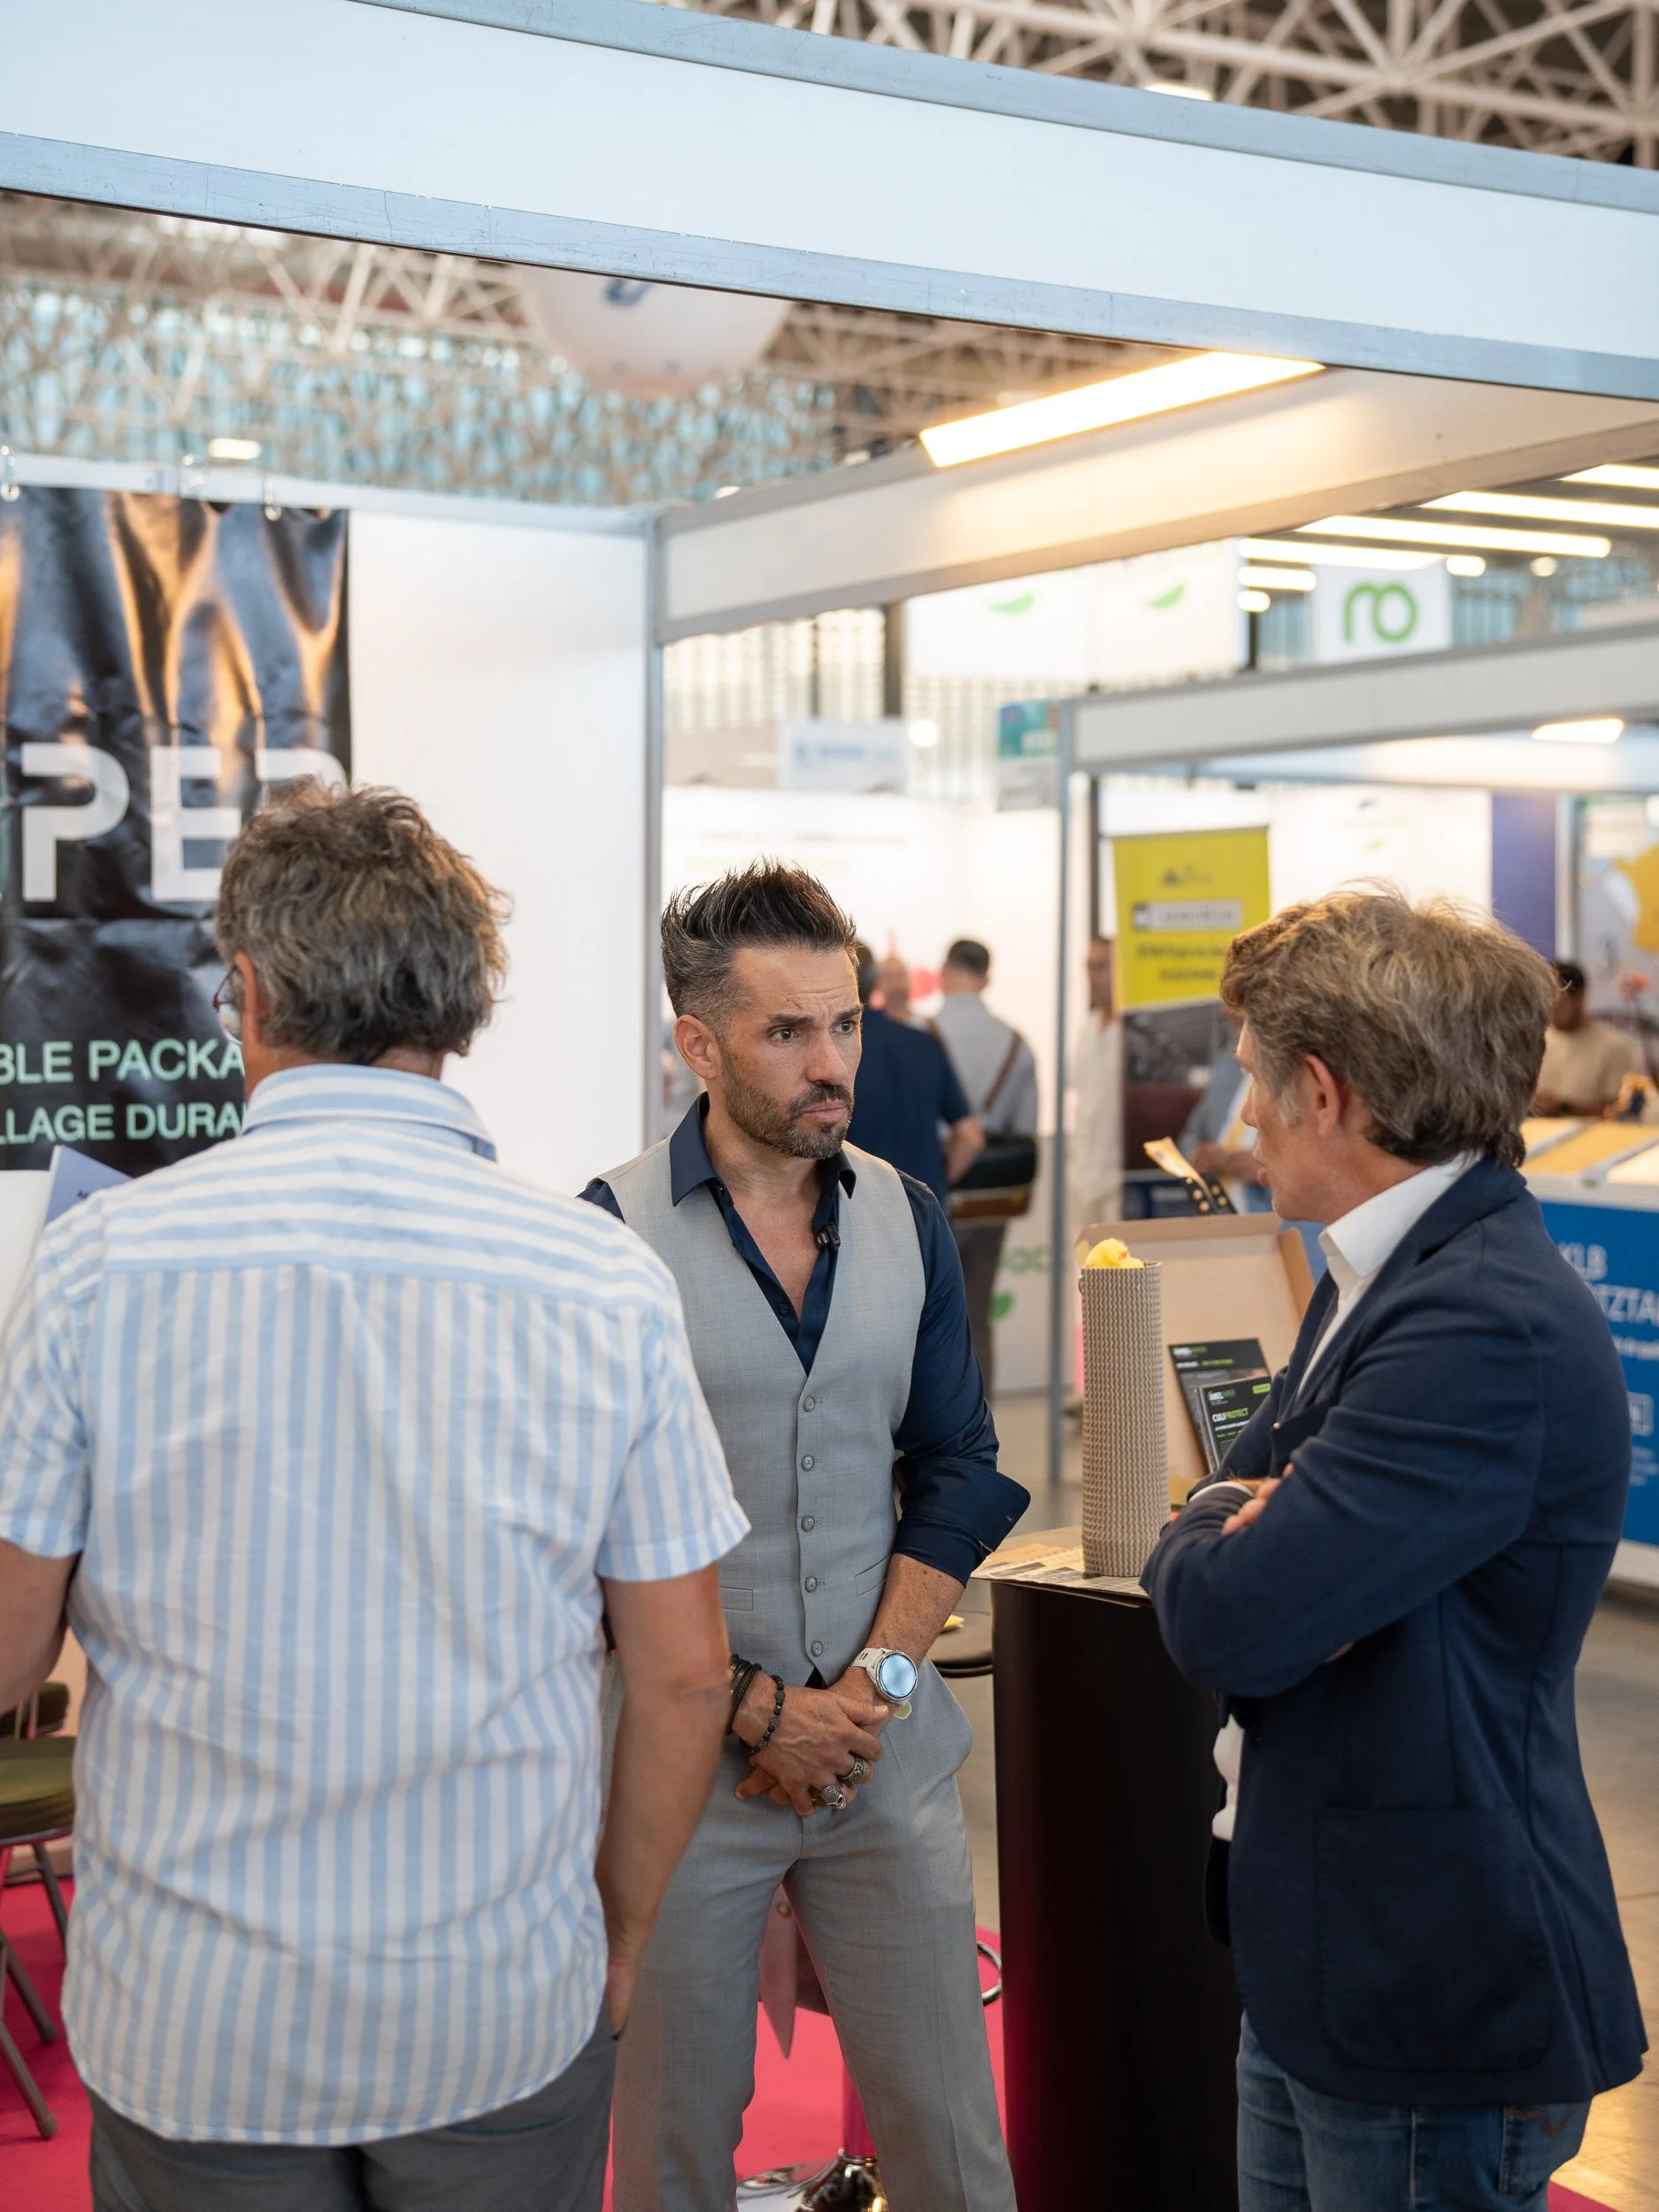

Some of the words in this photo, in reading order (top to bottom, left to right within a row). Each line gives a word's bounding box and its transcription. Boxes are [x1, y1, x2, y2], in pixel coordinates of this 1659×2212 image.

[88, 1039, 245, 1081] PACKA
[0, 1104, 115, 1145] LAGE
[127, 1102, 248, 1140] DURA
